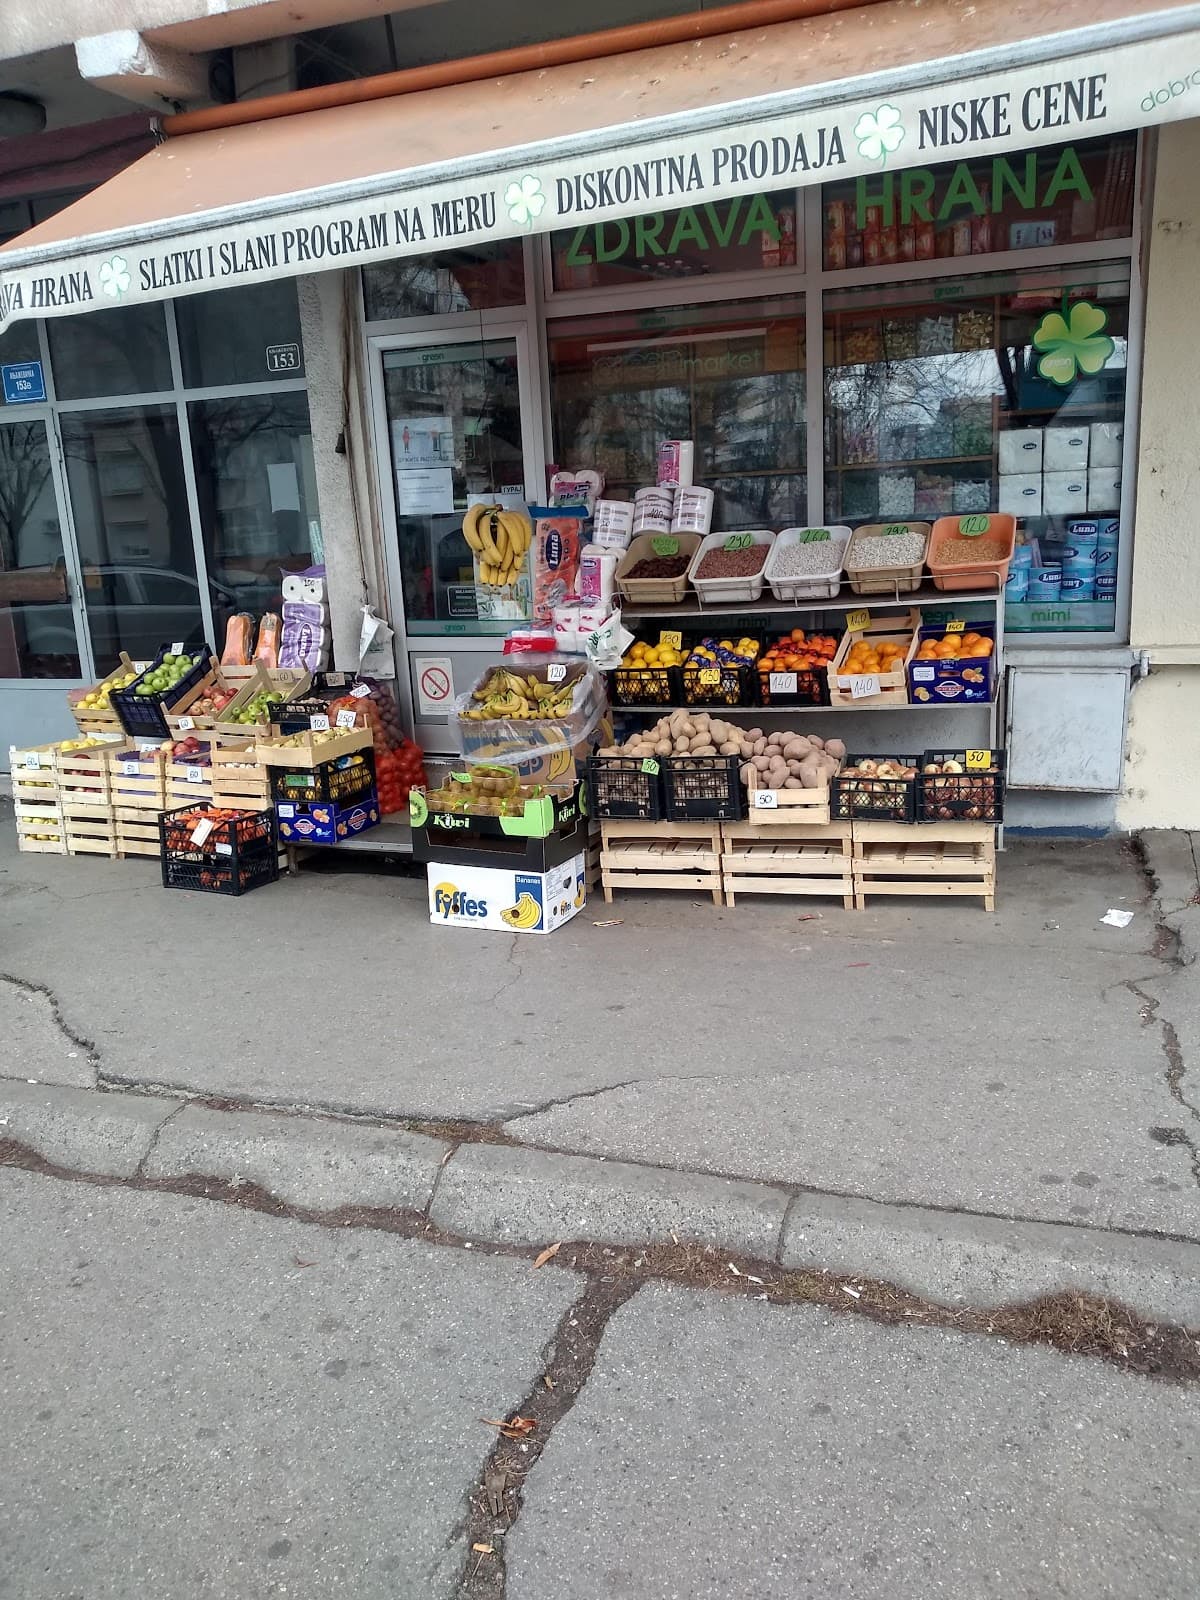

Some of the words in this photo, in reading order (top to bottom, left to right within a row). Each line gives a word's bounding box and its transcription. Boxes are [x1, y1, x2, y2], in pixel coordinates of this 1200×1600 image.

[918, 92, 1011, 150] NISKE
[1021, 73, 1107, 132] CENE
[555, 152, 705, 215] DISKONTNA
[712, 126, 847, 187] PRODAJA
[566, 192, 782, 266] ZDRAVA
[855, 147, 1094, 230] HRANA
[139, 248, 203, 291] SLATKI
[207, 246, 215, 278] I
[220, 233, 278, 276] SLANI
[281, 214, 390, 264] PROGRAM
[394, 207, 427, 244] NA
[431, 191, 497, 238] MERU
[30, 270, 94, 308] HRANA
[273, 352, 295, 369] 153
[682, 350, 761, 371] market
[961, 516, 988, 533] 120
[1072, 525, 1096, 533] Luna
[549, 534, 559, 565] Luna
[1031, 608, 1071, 622] mimi
[444, 624, 466, 633] green
[771, 674, 792, 689] 140
[853, 677, 874, 695] 140
[312, 719, 327, 729] 100
[338, 713, 353, 728] 250
[968, 751, 984, 762] 50
[759, 794, 772, 804] 50
[433, 814, 470, 829] Kiwi
[558, 804, 576, 823] Kiwi
